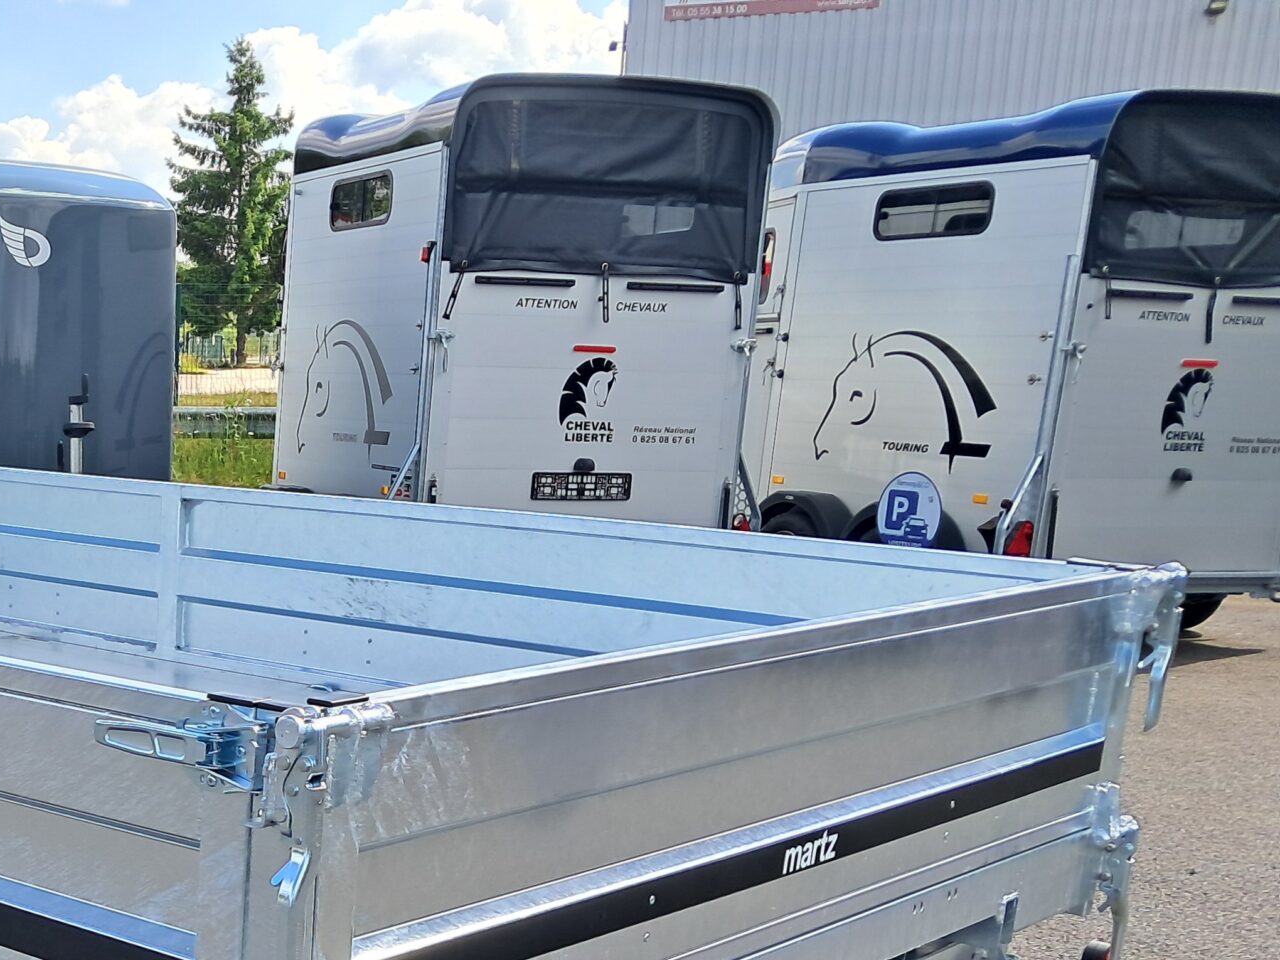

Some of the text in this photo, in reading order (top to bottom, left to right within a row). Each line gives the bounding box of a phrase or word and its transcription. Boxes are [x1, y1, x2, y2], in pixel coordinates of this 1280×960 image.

[515, 297, 578, 310] ATTENTION
[615, 301, 667, 313] CHEVAUX
[1139, 310, 1190, 322] ATTENTION
[1222, 315, 1265, 326] CHEVAUX
[566, 421, 614, 432] CHEVAL
[632, 435, 638, 443] 0
[640, 435, 657, 443] 825
[672, 436, 683, 444] 67
[685, 436, 695, 444] 61
[1165, 431, 1205, 441] CHEVAL
[882, 441, 929, 453] TOURING
[781, 829, 839, 874] martz
